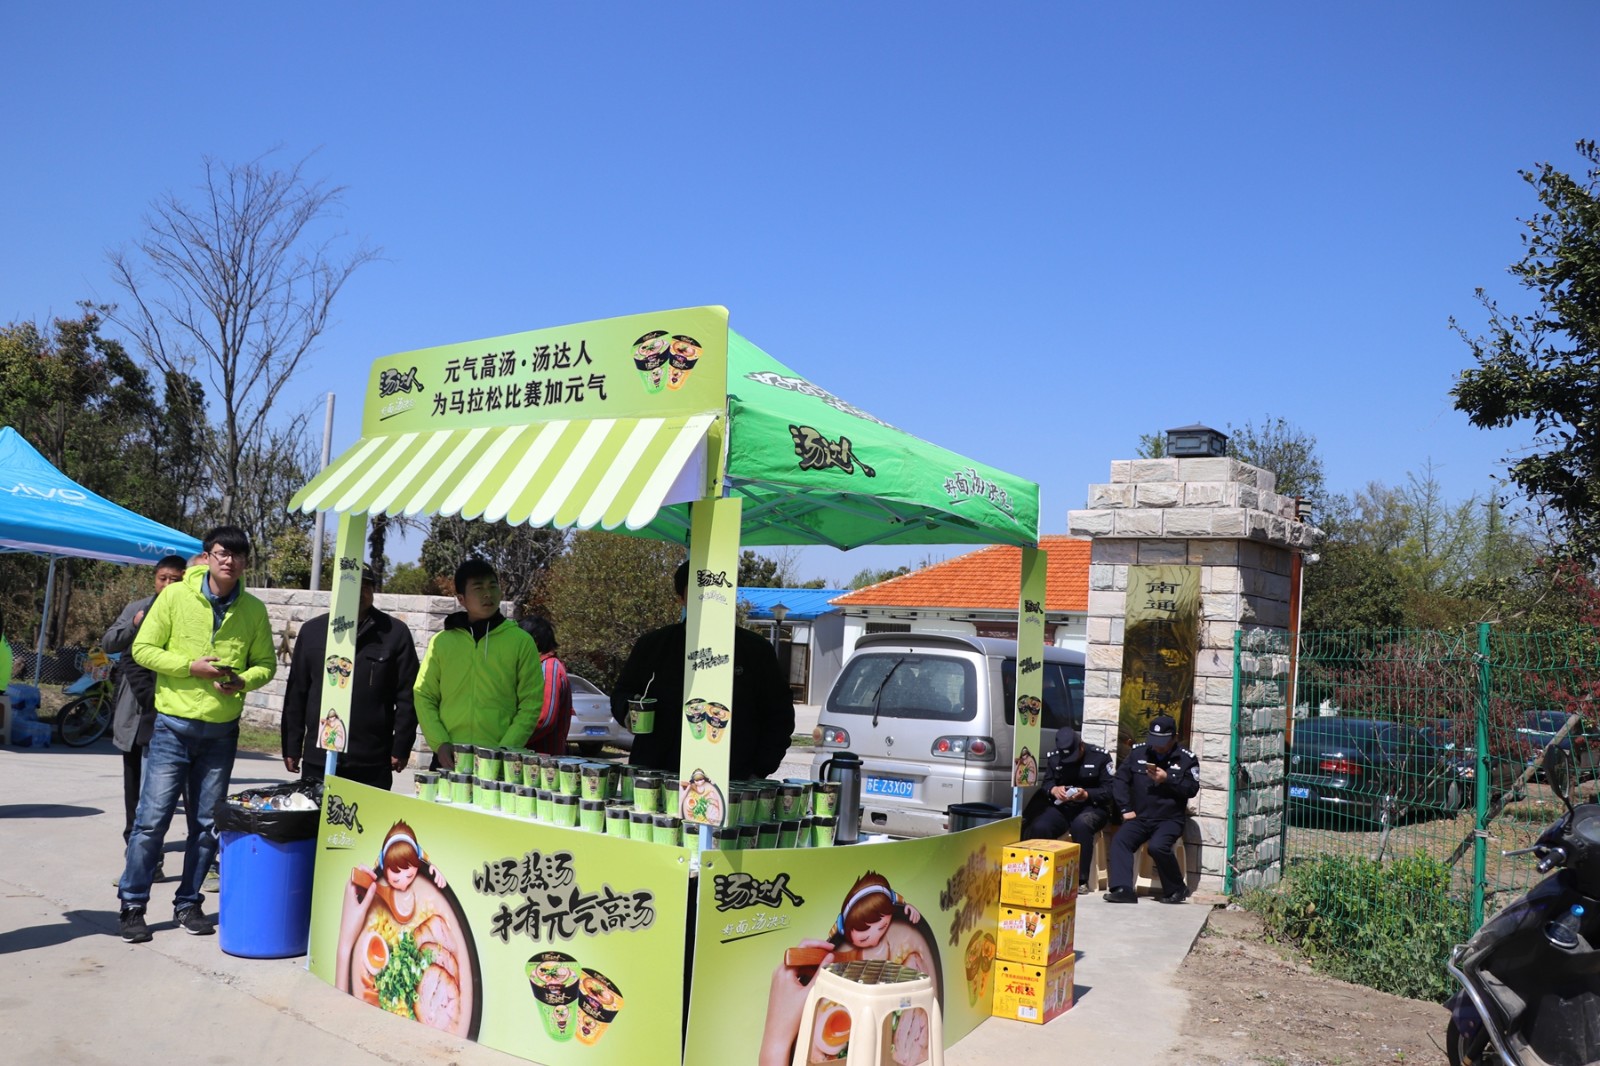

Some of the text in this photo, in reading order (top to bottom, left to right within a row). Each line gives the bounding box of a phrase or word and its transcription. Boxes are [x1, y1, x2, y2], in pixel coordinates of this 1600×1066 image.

[379, 366, 425, 398] 汤达人
[443, 339, 594, 384] 元气高汤·汤达人
[430, 373, 608, 418] 为马拉松比赛加元气
[788, 424, 877, 478] 汤达人
[696, 569, 733, 588] 汤达人
[326, 794, 364, 834] 汤达人
[474, 853, 575, 894] 以汤熬汤
[713, 872, 805, 912] 汤达人
[491, 887, 655, 942] 才有元气高汤
